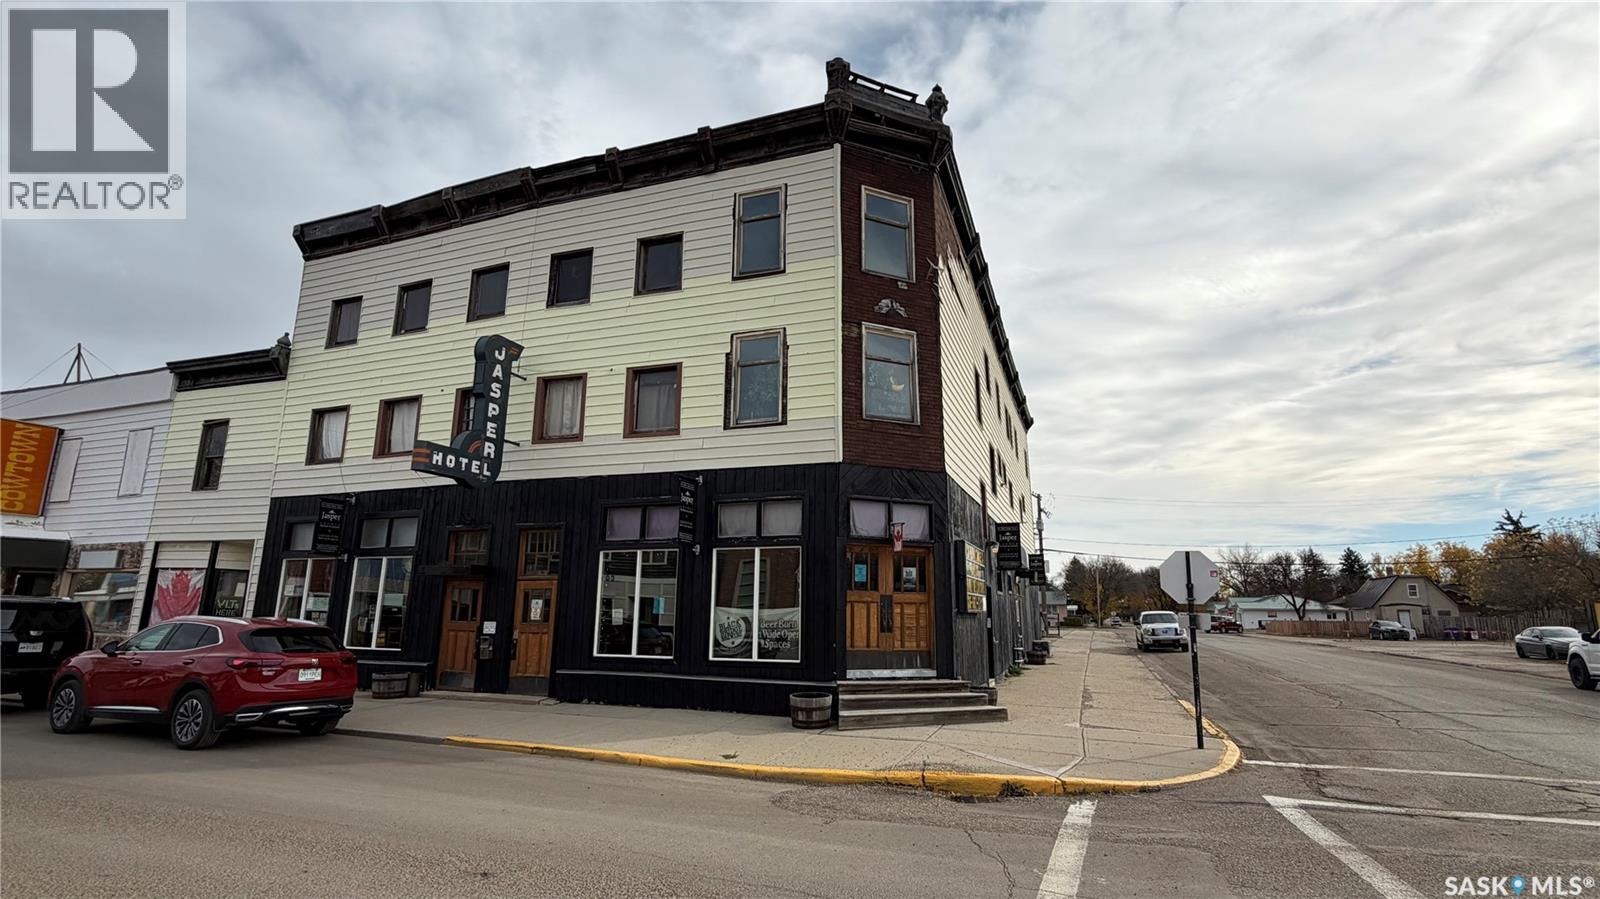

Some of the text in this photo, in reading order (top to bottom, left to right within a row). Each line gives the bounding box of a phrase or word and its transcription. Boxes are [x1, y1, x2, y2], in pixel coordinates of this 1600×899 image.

[483, 347, 506, 459] JASPER
[0, 423, 41, 511] COWTOWN
[432, 450, 492, 477] HOTEL
[321, 511, 341, 521] Jasper
[764, 639, 792, 651] Spaces
